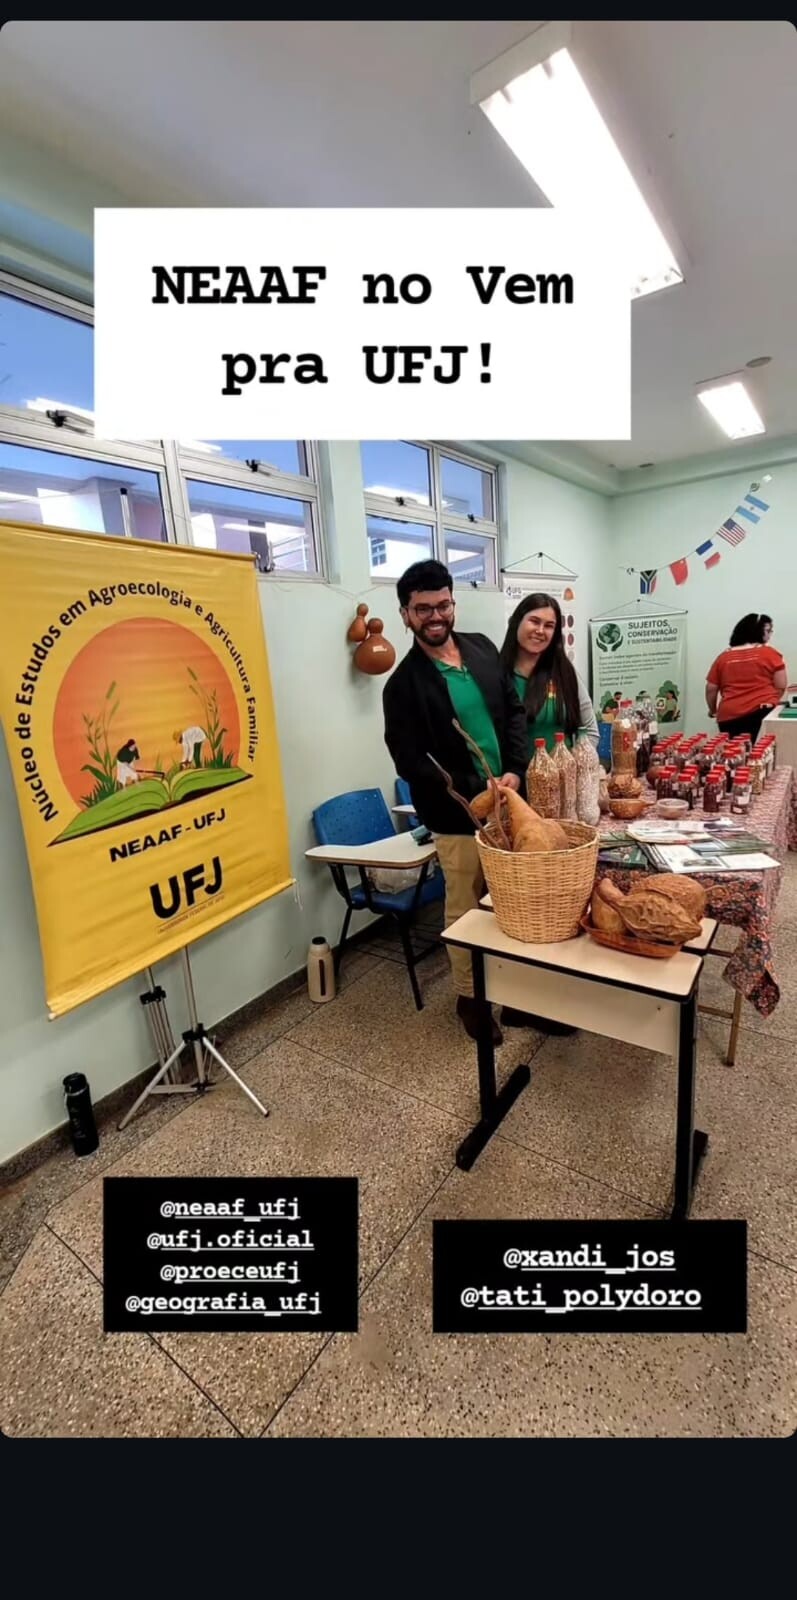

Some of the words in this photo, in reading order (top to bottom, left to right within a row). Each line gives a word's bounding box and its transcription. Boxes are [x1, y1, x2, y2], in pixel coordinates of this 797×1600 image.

[59, 599, 88, 627] em
[87, 581, 193, 609] Agroecologia
[194, 604, 204, 615] e
[627, 619, 671, 629] SUJEITOS,
[627, 627, 678, 638] CONSERVAÇÃO
[16, 623, 62, 706] Estudos
[203, 612, 251, 693] Agricultura
[14, 712, 31, 740] de
[246, 696, 260, 763] Familiar
[20, 750, 59, 822] Núcleo
[109, 823, 183, 863] NEAAF
[193, 807, 226, 831] UFJ
[149, 855, 223, 920] UFJ
